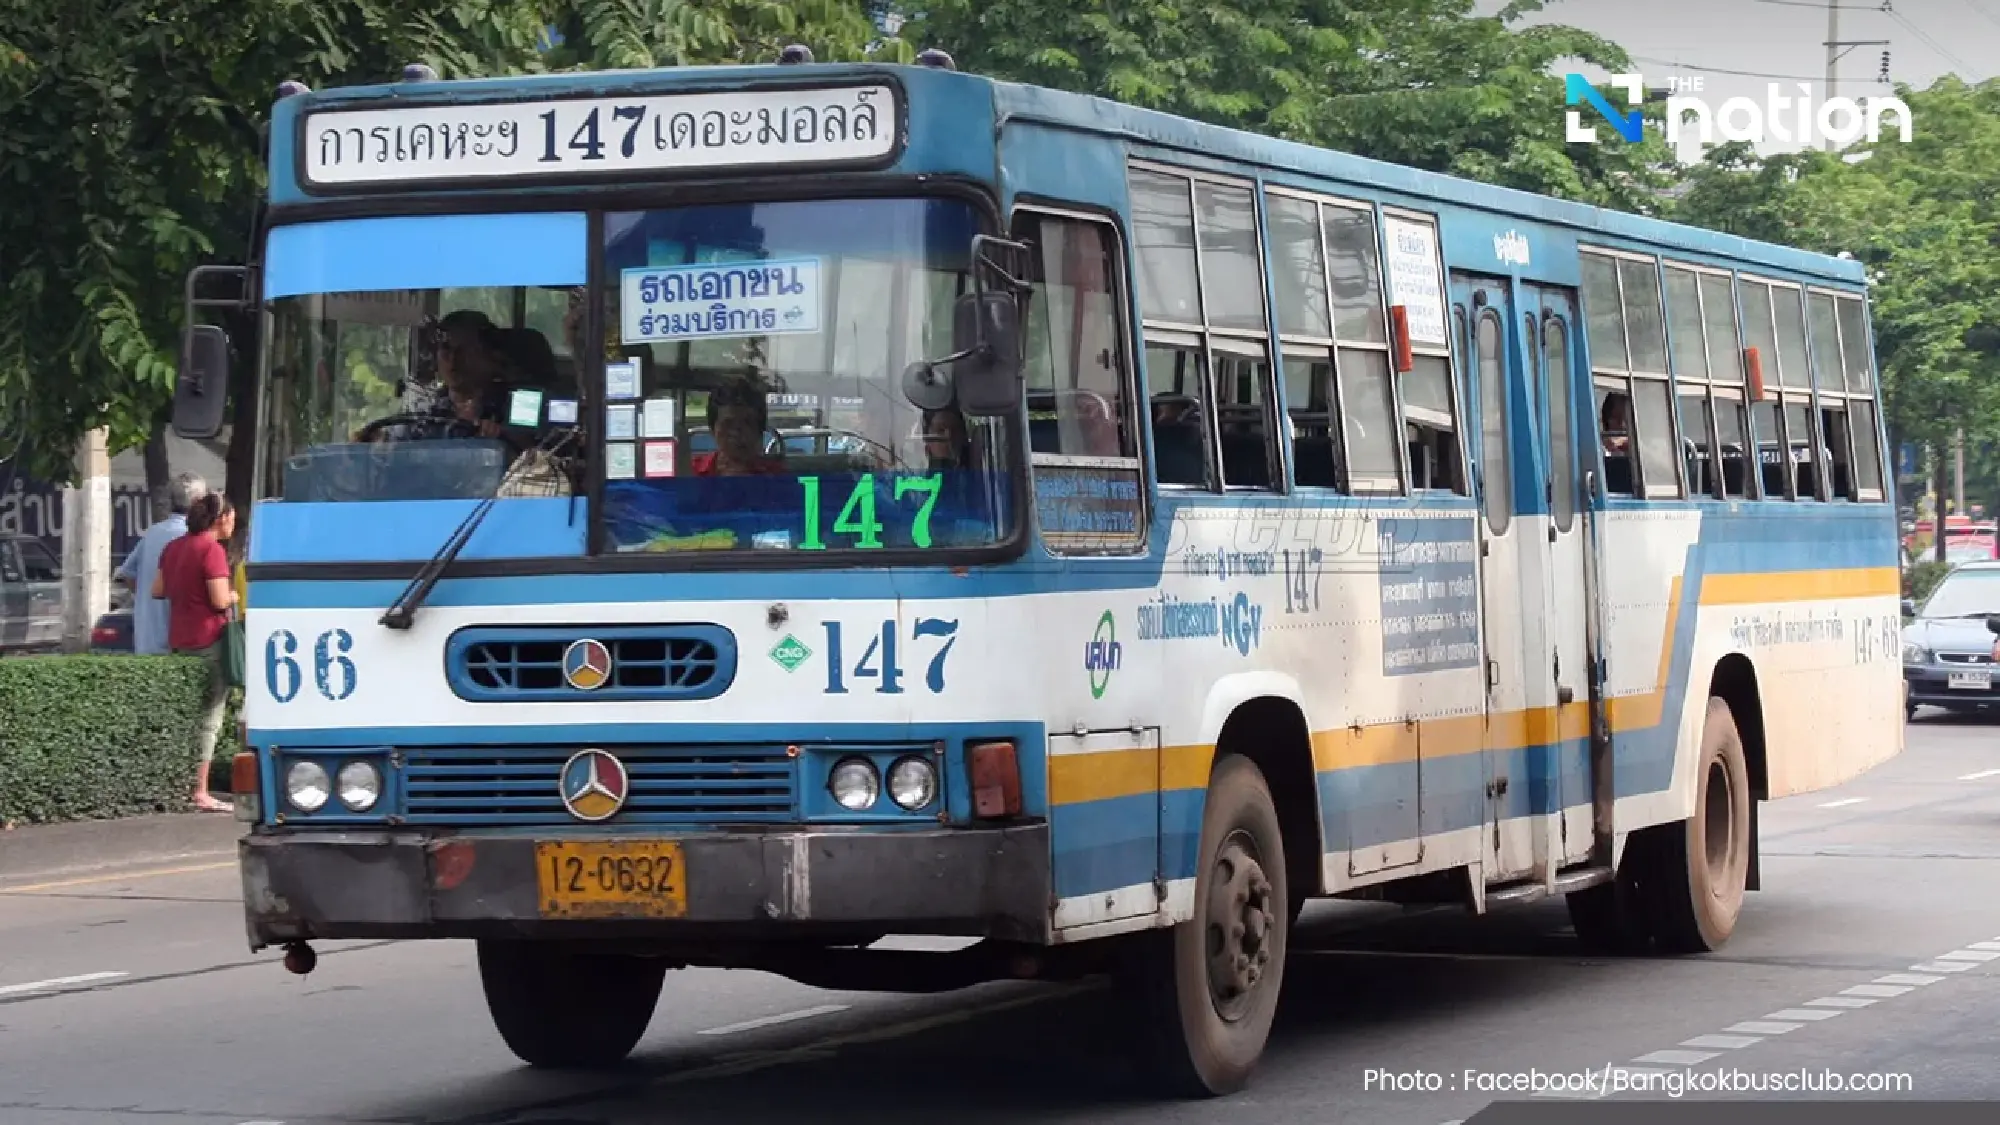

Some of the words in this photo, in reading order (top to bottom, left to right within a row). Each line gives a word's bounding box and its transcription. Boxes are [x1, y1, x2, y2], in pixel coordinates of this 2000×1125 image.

[319, 120, 518, 166] การเคหะฯ
[537, 105, 647, 163] 147
[653, 88, 878, 160] เดอะมอลล์
[640, 266, 804, 303] รถเอกชน
[639, 303, 776, 335] ร่วมบริการ
[798, 473, 943, 550] 147
[1283, 549, 1322, 614] 147
[776, 648, 804, 659] CNG
[820, 618, 959, 694] 147
[1221, 591, 1262, 657] NGV
[264, 630, 357, 703] 66
[551, 855, 675, 893] 12-0632
